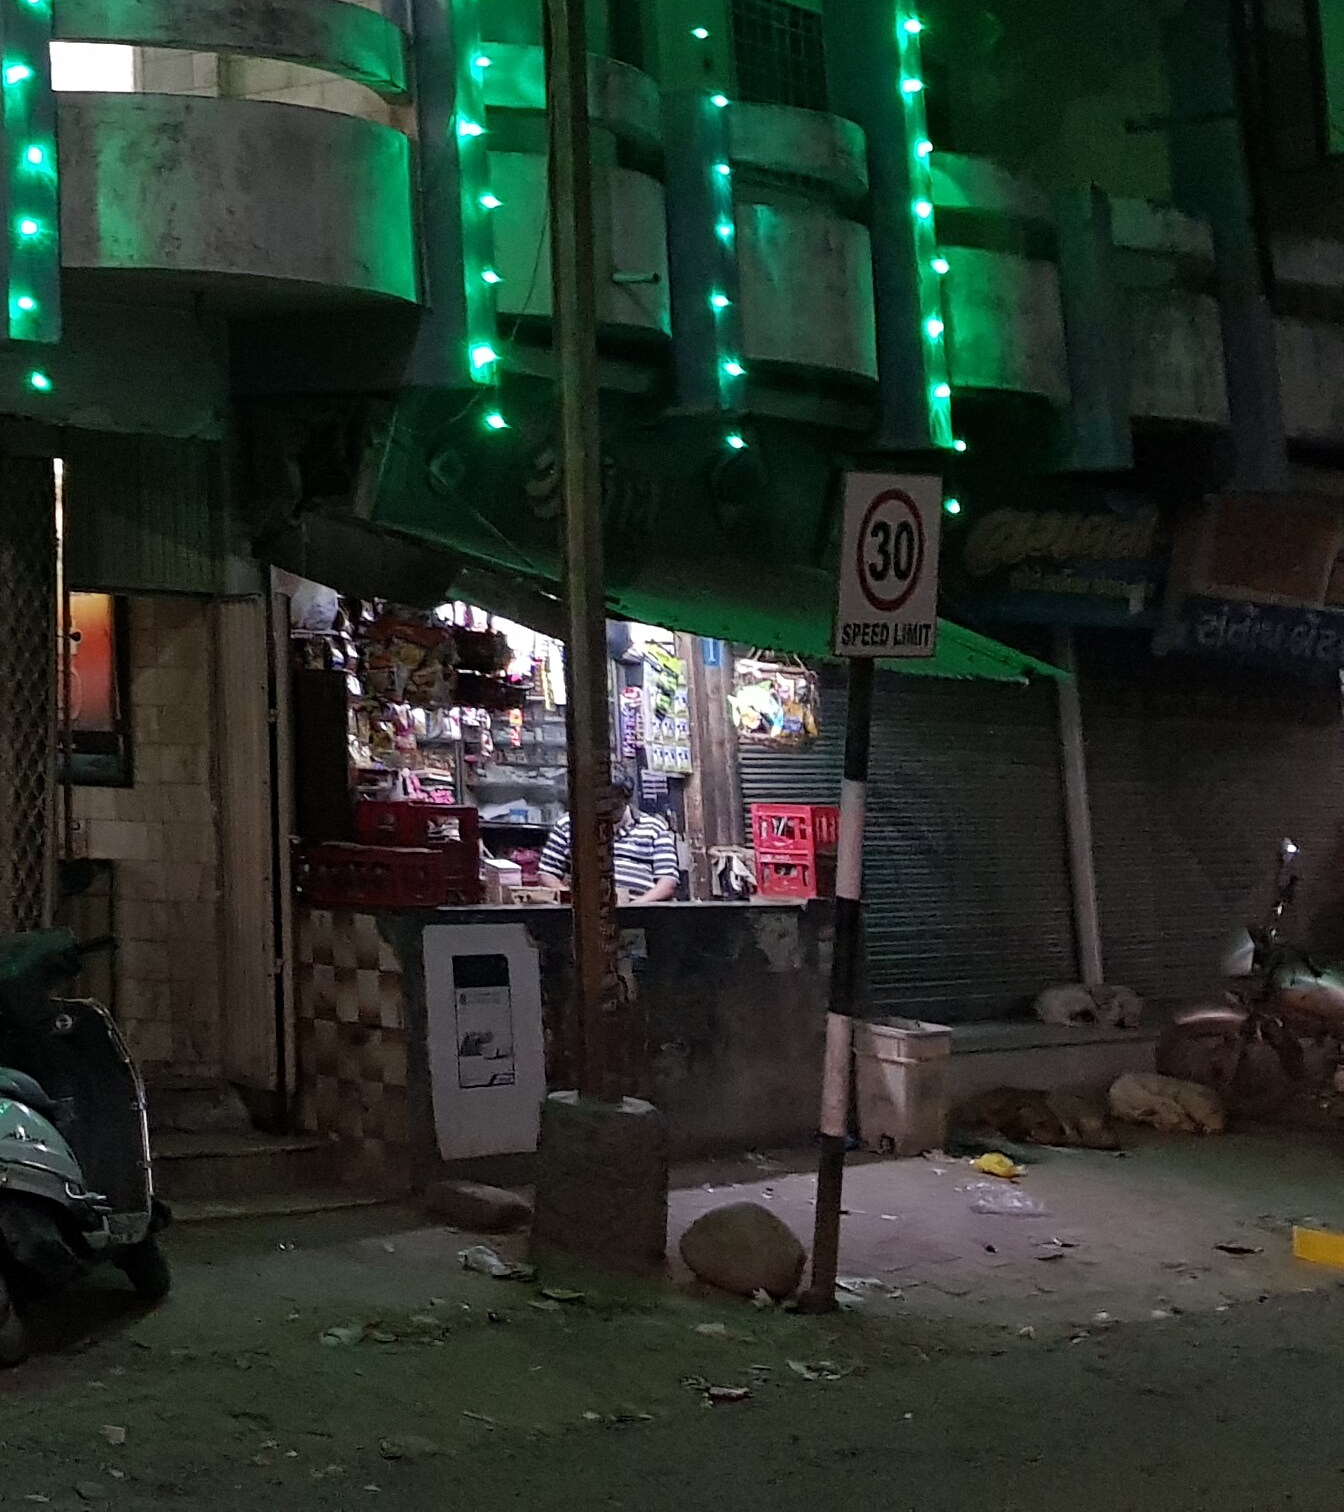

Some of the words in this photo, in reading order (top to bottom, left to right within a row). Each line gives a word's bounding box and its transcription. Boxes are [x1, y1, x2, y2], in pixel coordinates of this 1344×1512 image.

[868, 519, 915, 582] 30
[841, 622, 890, 647] SPEED
[893, 623, 932, 648] LIMIT
